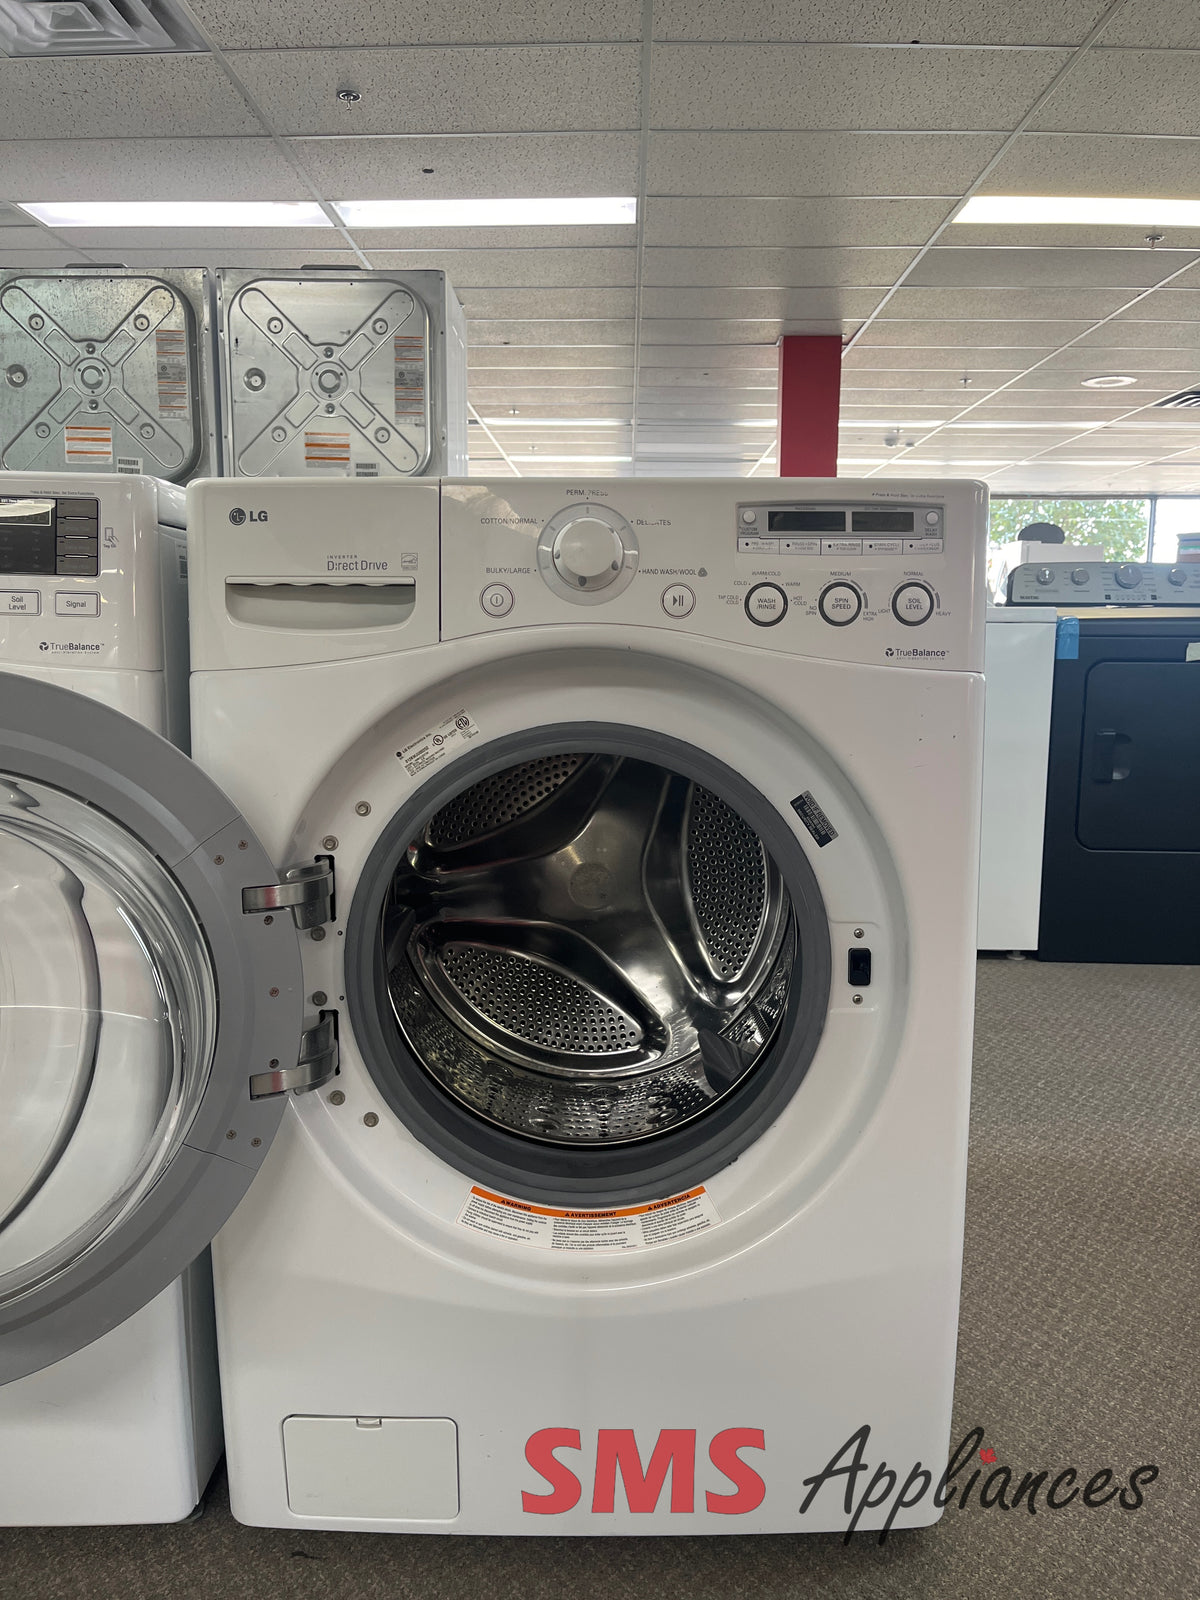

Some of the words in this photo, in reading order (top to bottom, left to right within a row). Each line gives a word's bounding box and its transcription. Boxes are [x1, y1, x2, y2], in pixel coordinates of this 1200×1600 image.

[249, 510, 269, 522] LG
[327, 560, 359, 571] Direct
[360, 560, 388, 571] Drive
[11, 595, 24, 603] Soil
[65, 600, 87, 609] Signal
[505, 1201, 532, 1212] WARNING
[653, 1193, 691, 1210] ADVERTENCIA
